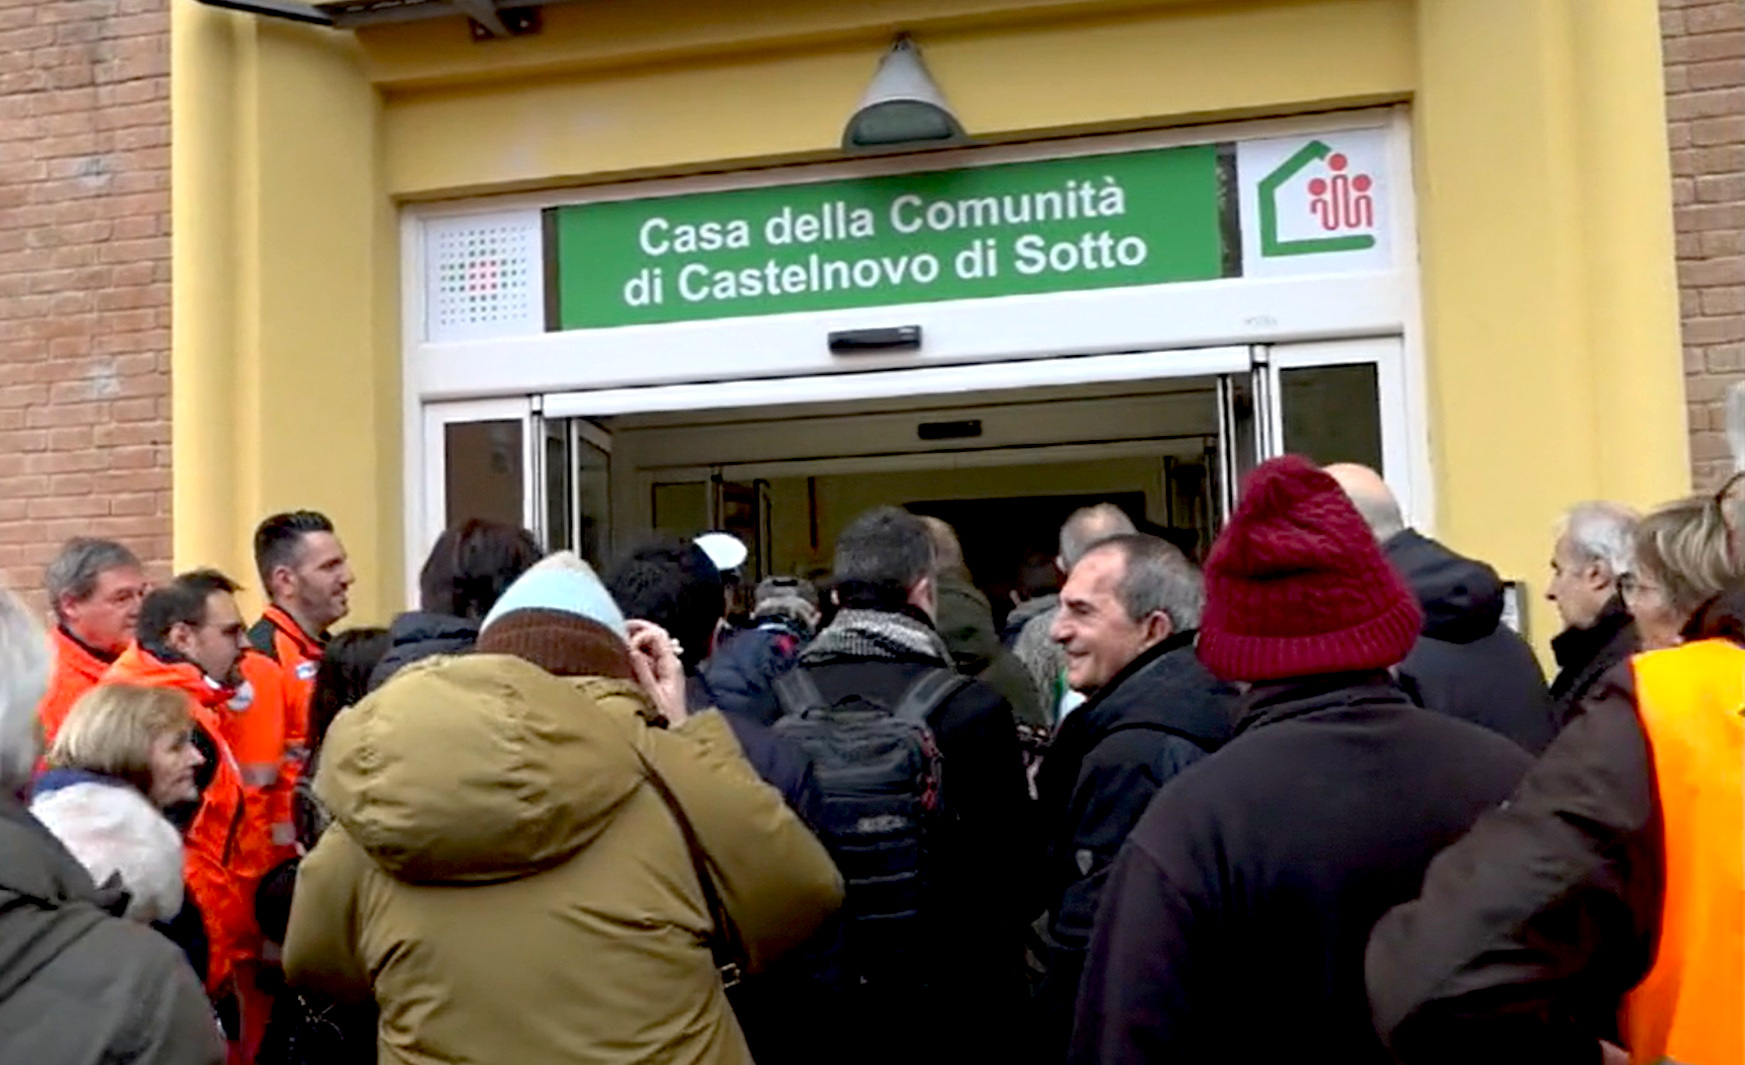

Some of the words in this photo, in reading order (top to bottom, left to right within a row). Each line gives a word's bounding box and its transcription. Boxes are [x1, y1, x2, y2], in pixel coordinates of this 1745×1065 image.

[639, 217, 750, 256] Casa
[764, 201, 875, 246] della
[891, 176, 1125, 233] Comunità
[623, 267, 663, 307] di
[678, 253, 940, 302] Castelnovo
[955, 238, 998, 280] di
[1014, 231, 1148, 275] Sotto
